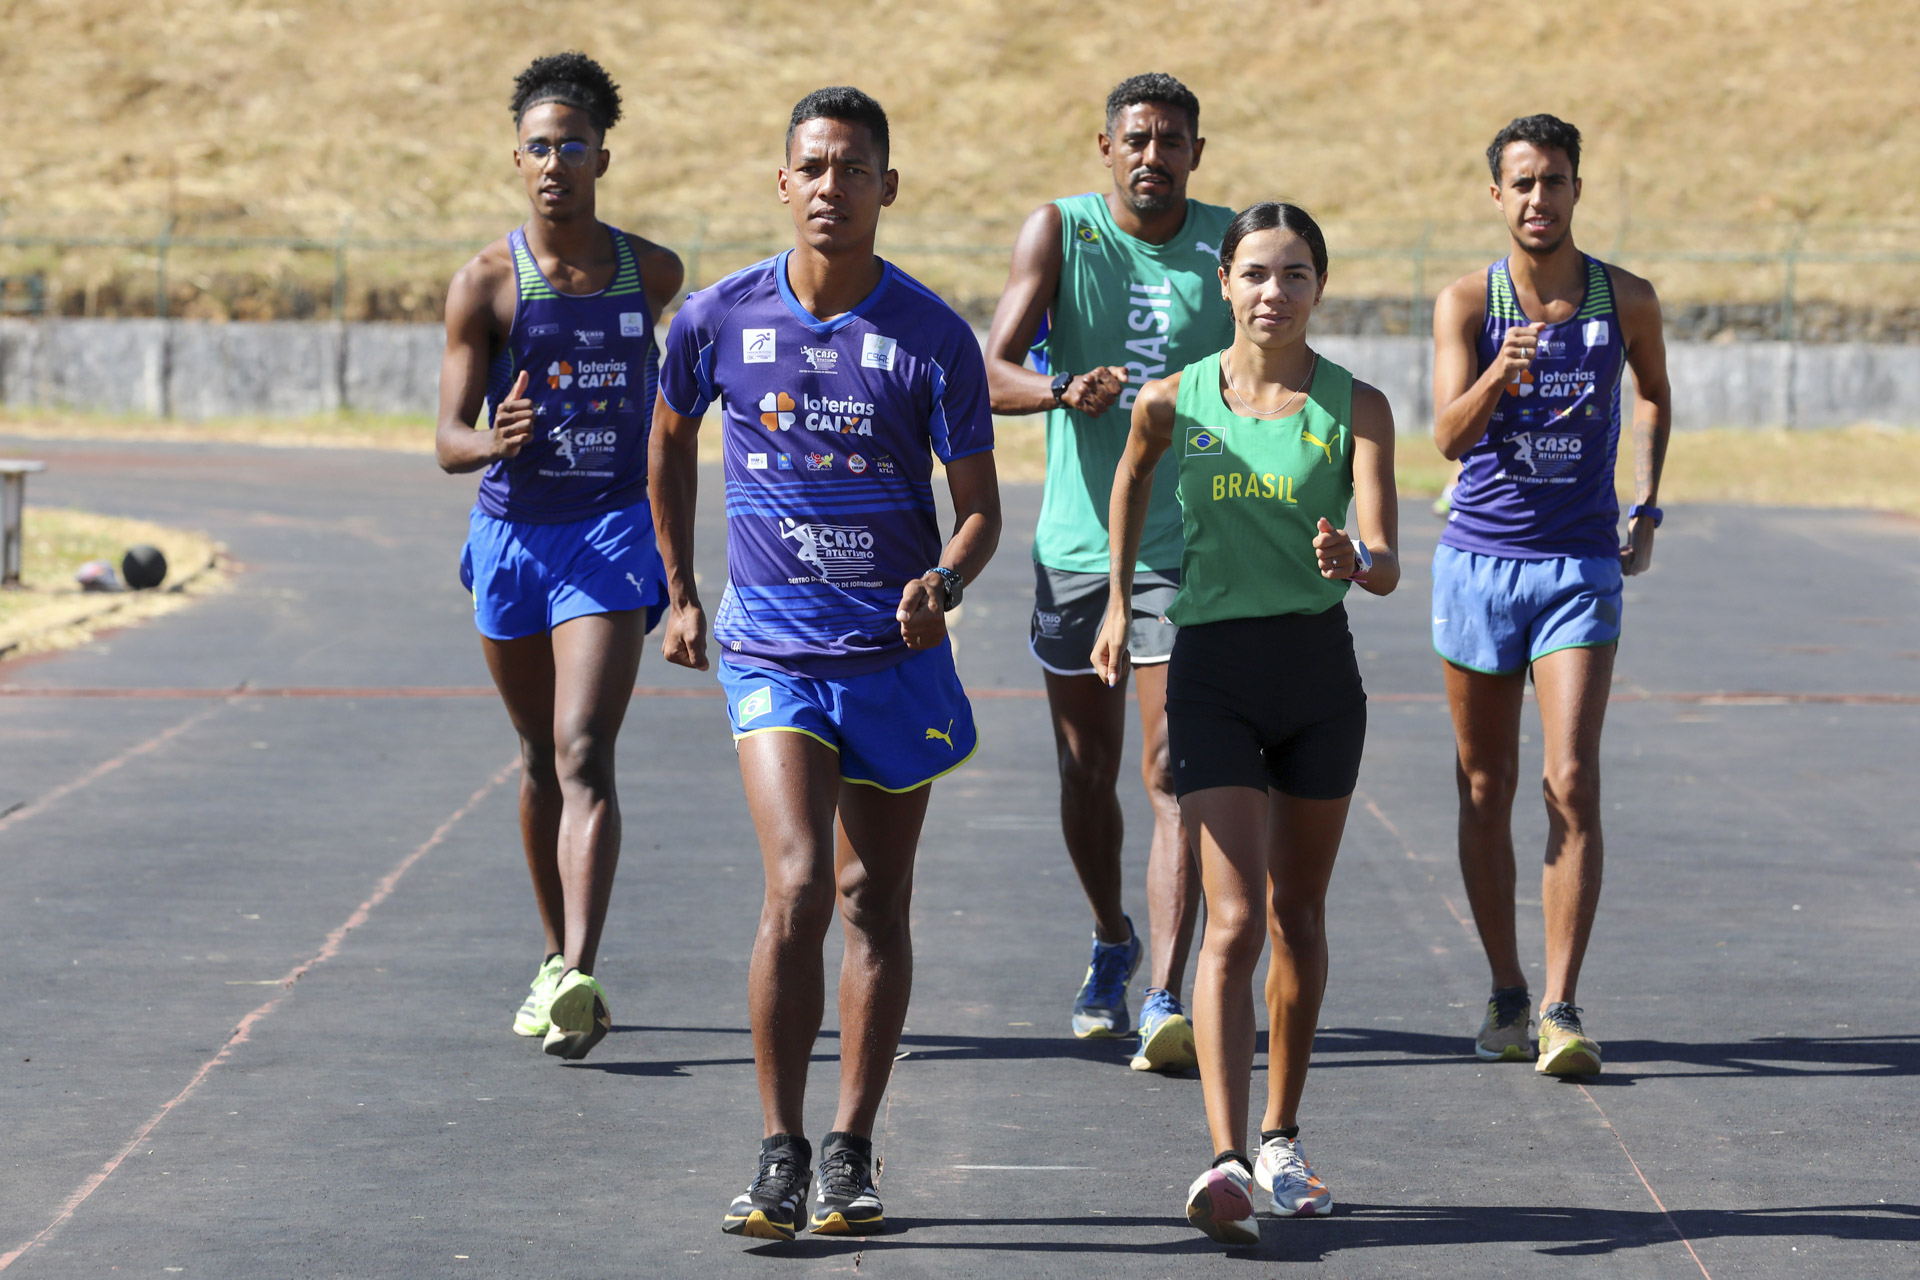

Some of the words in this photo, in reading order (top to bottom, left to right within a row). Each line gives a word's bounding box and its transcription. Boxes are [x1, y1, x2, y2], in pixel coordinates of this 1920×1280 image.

[815, 350, 838, 359] CASO
[577, 359, 628, 374] loterias
[577, 373, 627, 388] CAIXA
[1539, 368, 1596, 381] loterias
[1539, 382, 1596, 397] CAIXA
[803, 393, 875, 416] loterias
[804, 413, 873, 437] CAIXA
[574, 431, 617, 446] CASO
[1534, 437, 1583, 451] CASO
[1538, 452, 1582, 460] ATLETISMO
[1212, 472, 1298, 504] BRASIL
[819, 529, 875, 549] CASO
[825, 549, 874, 559] ATLETISMO
